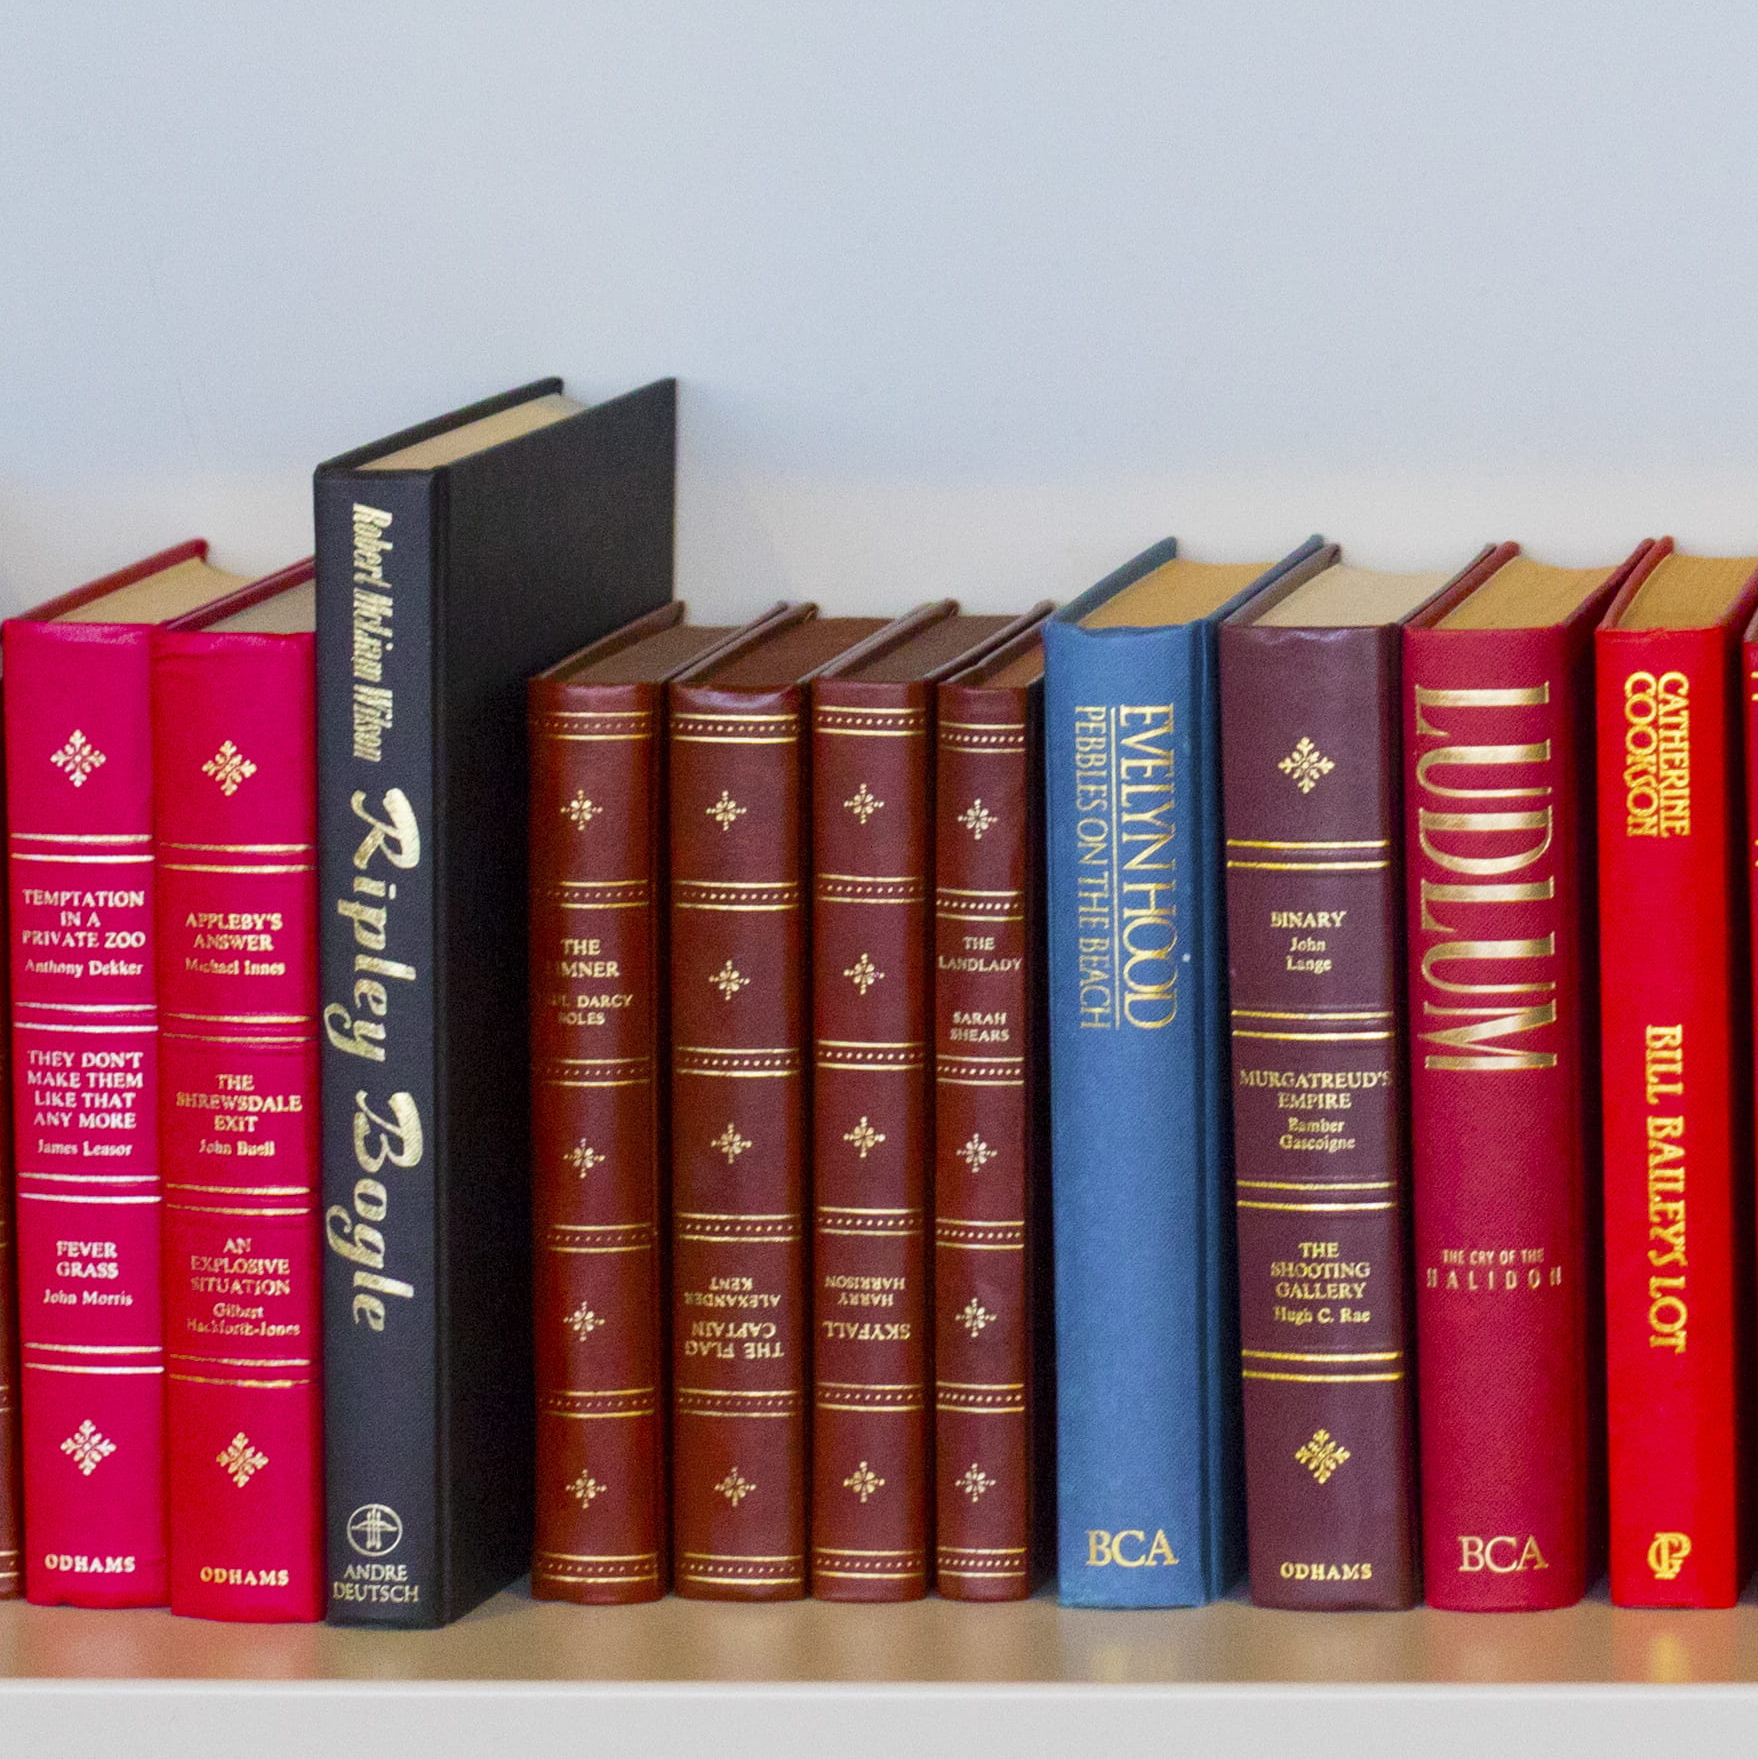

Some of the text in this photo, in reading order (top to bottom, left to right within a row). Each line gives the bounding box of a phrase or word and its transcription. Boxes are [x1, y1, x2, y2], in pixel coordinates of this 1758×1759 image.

[1624, 672, 1658, 838] COOKSON
[1657, 672, 1691, 838] CATHERINE
[1075, 705, 1112, 1029] PEBBLES ON THE BEACH
[1119, 704, 1179, 1029] EVELYN HOOD
[1416, 681, 1557, 1070] LUDLUM
[105, 932, 145, 948] ZOO
[952, 1011, 1007, 1025] SARAH
[323, 788, 423, 1331] Ripley Bogle
[57, 1241, 117, 1258] FEVER
[1298, 1243, 1339, 1258] THE
[57, 1262, 118, 1278] GRASS
[1275, 1282, 1366, 1299] GALLERY
[1086, 1529, 1179, 1568] BCA
[1459, 1537, 1548, 1572] BCA
[45, 1555, 135, 1573] ODHAMS
[334, 1583, 419, 1602] DEUTSCH
